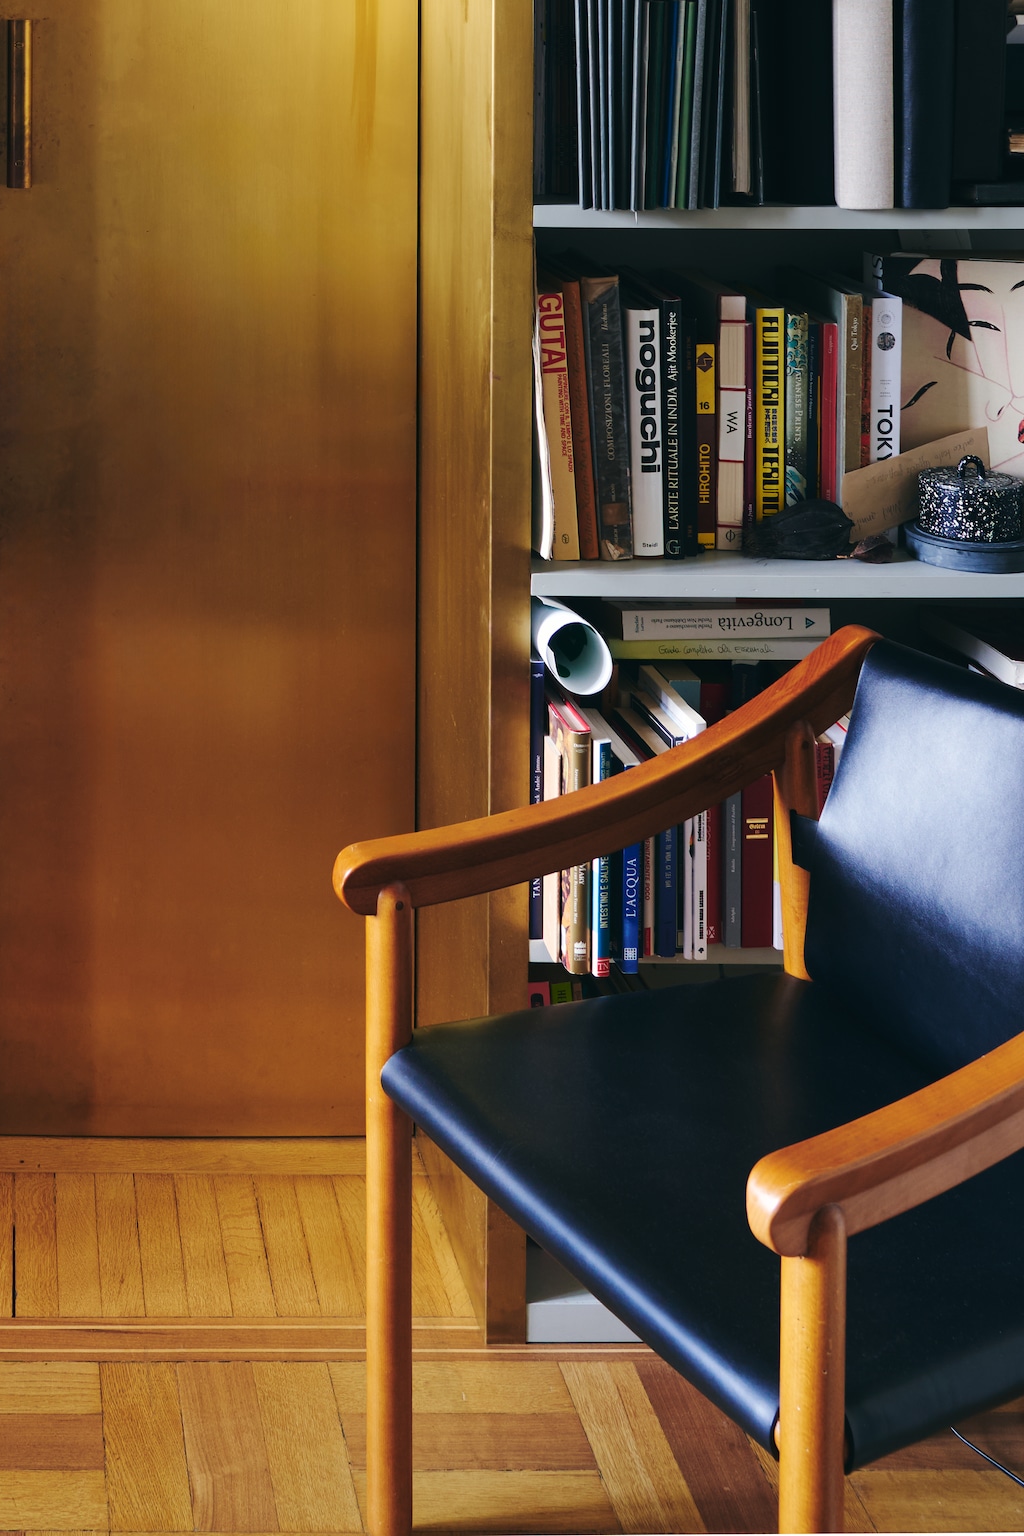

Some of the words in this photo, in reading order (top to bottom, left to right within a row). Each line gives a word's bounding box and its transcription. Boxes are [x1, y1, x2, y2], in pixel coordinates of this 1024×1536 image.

[538, 293, 567, 374] GUTAI
[667, 312, 679, 361] Mookerjee
[636, 320, 661, 473] noguchi
[667, 388, 678, 419] INDIA
[698, 402, 710, 410] 16
[726, 411, 738, 434] WA
[699, 443, 710, 504] HIROHITO
[718, 612, 794, 631] Longevità
